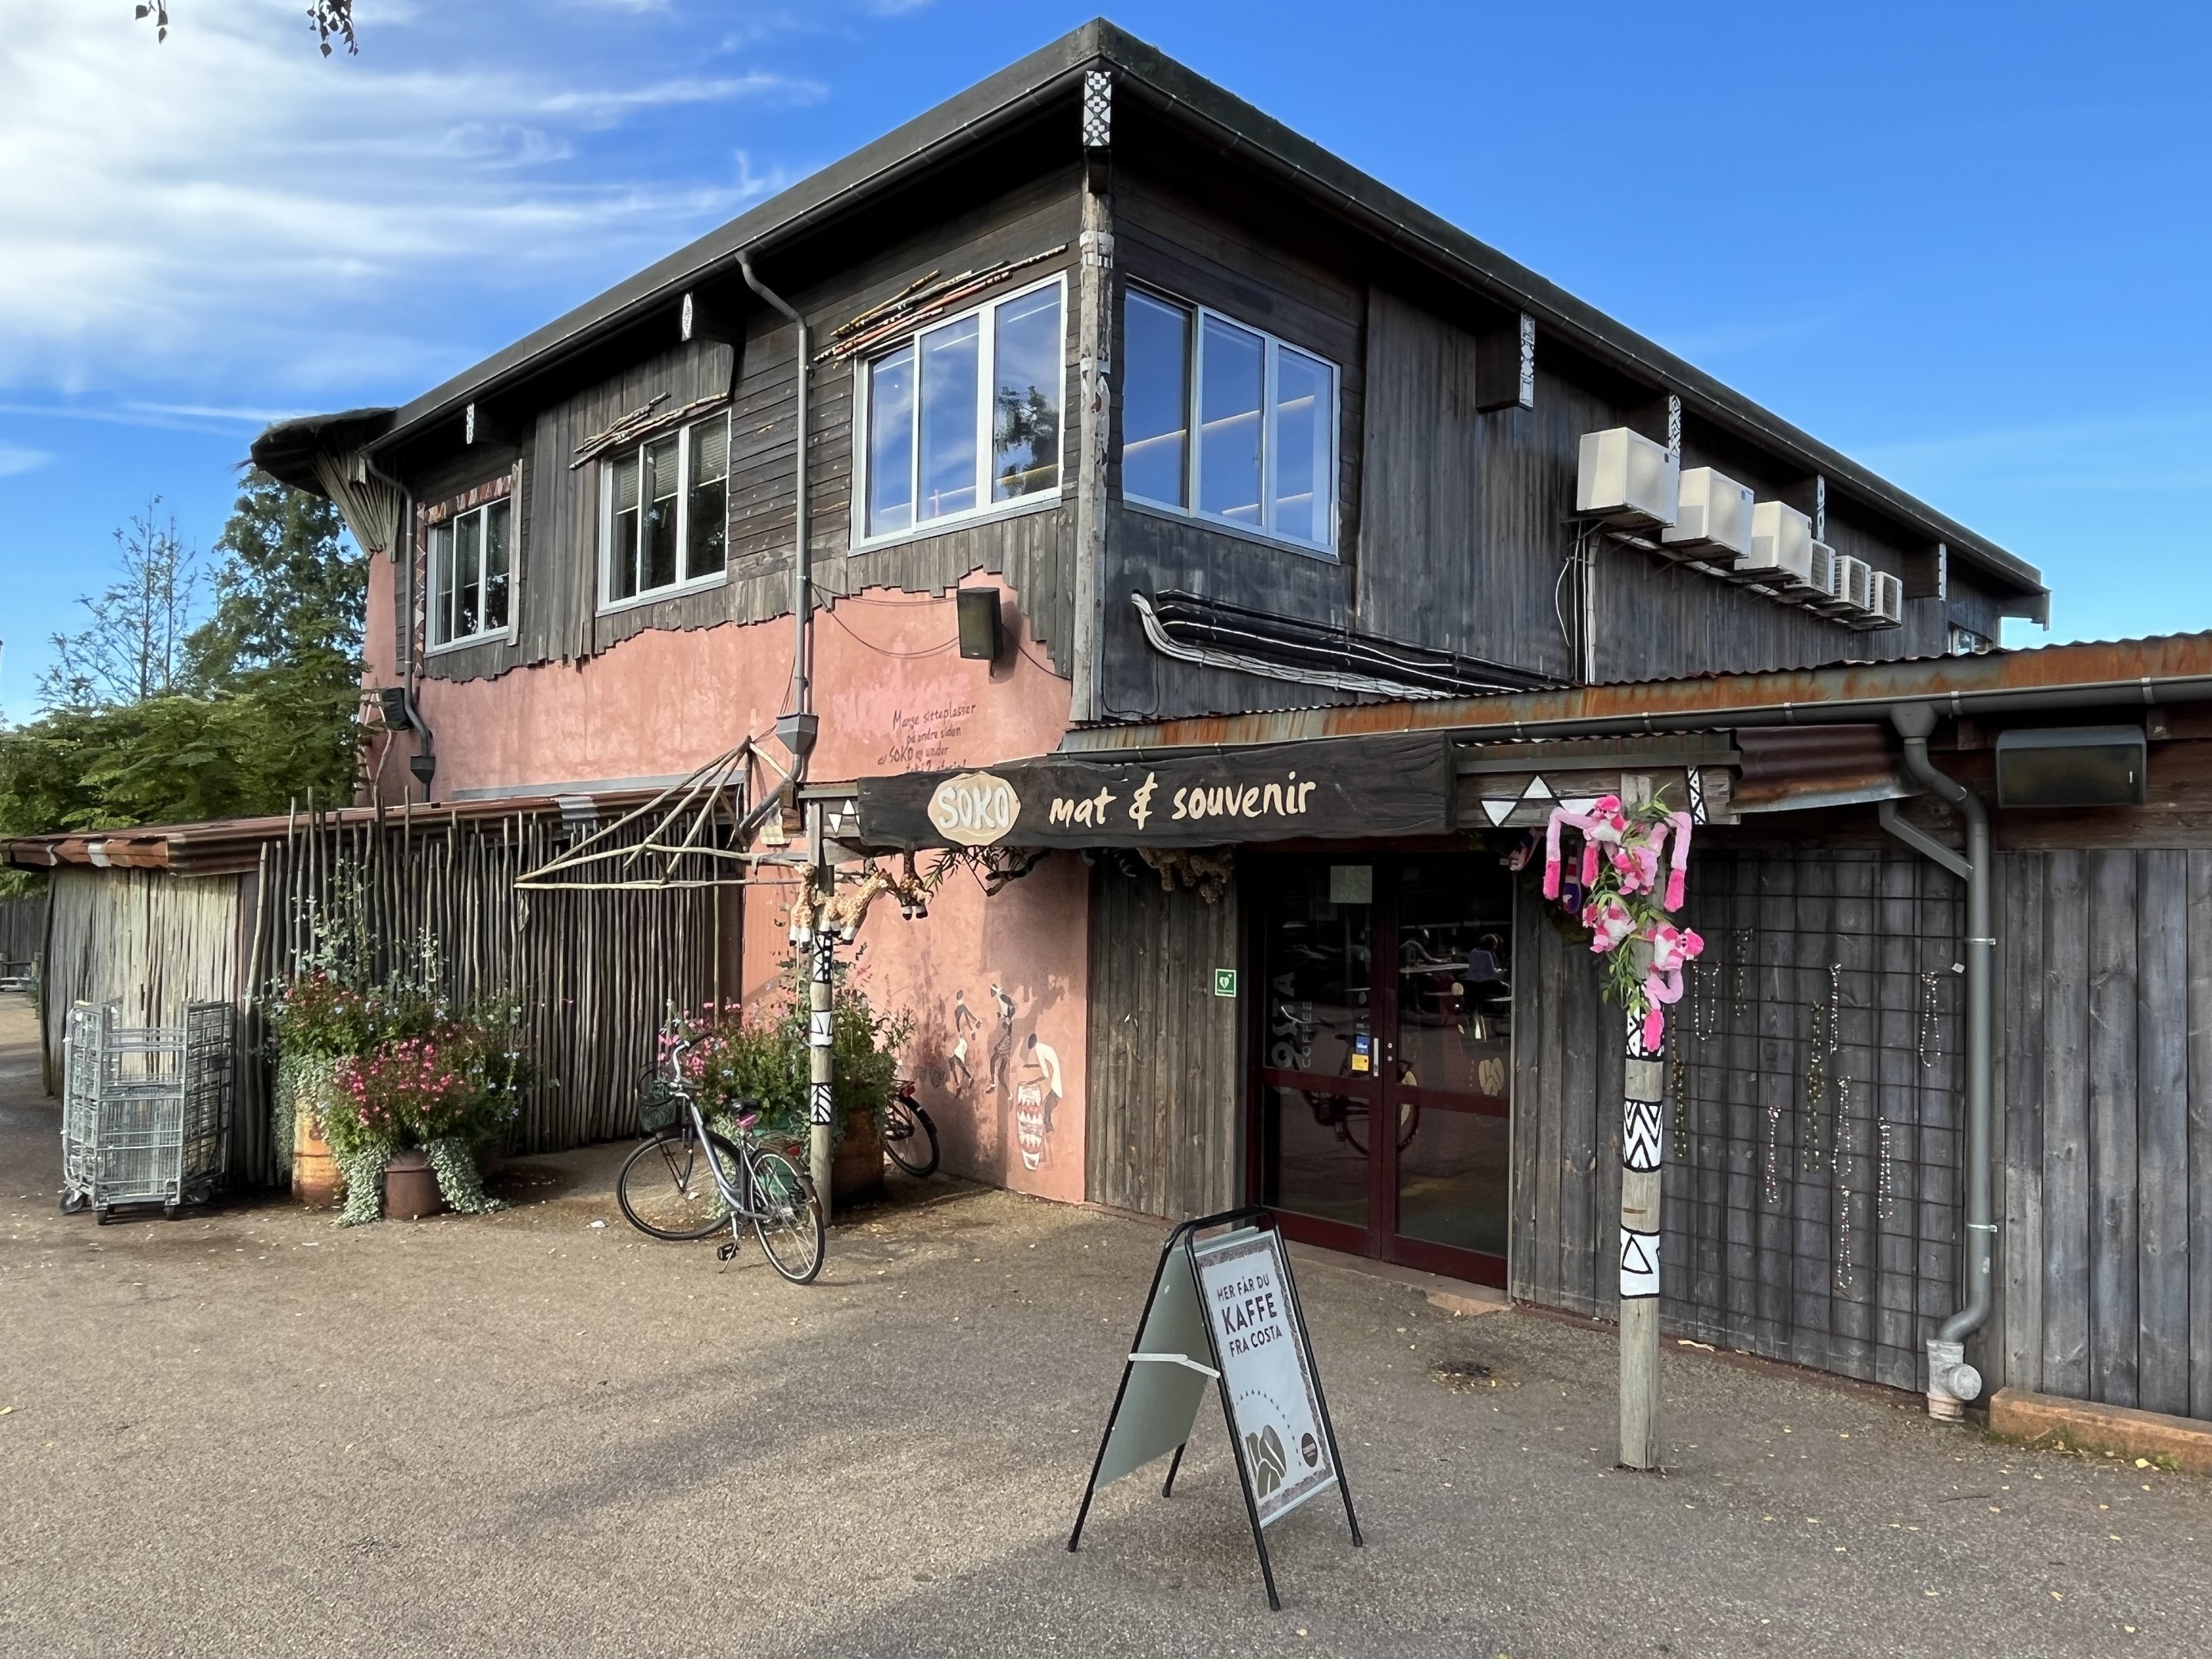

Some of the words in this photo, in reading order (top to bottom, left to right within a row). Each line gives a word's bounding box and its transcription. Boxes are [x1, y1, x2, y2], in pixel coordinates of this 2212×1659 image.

[892, 709, 919, 732] Mange
[923, 700, 976, 724] sitteplasser
[889, 744, 914, 763] SOKO
[926, 741, 949, 757] under
[938, 784, 1012, 830] SOKO
[1049, 786, 1118, 830] mat
[1128, 771, 1158, 831] &
[1171, 770, 1316, 820] souvenir
[1302, 1001, 1312, 1068] COFFEE
[1217, 1284, 1236, 1303] HER
[1237, 1275, 1255, 1296] FÅR
[1257, 1273, 1270, 1290] DU
[1221, 1292, 1277, 1335] KAFFE
[1229, 1336, 1250, 1358] FRA
[1250, 1324, 1283, 1348] COSTA
